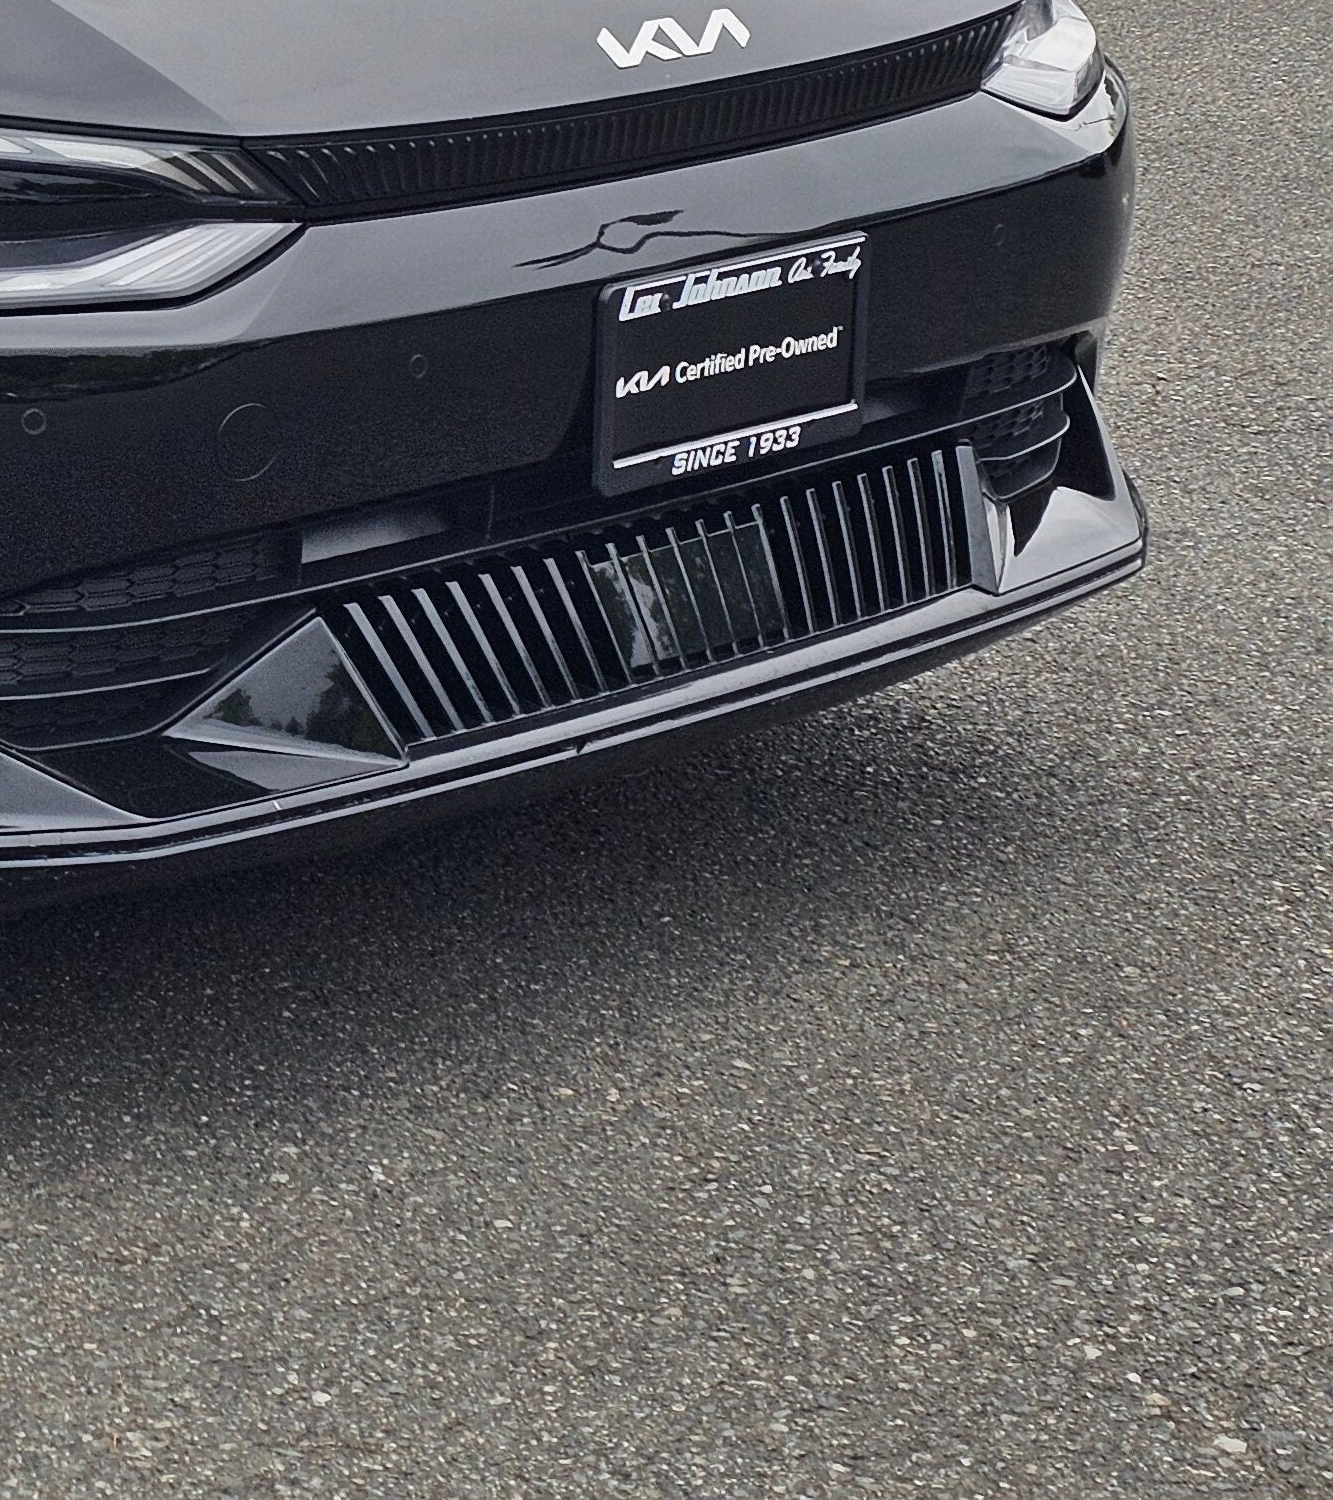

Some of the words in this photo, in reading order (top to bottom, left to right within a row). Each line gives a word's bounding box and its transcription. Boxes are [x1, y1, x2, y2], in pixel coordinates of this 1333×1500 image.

[675, 348, 745, 384] Certified
[748, 326, 839, 367] Pre-Owned
[671, 440, 740, 476] SINCE
[747, 425, 802, 458] 1933
